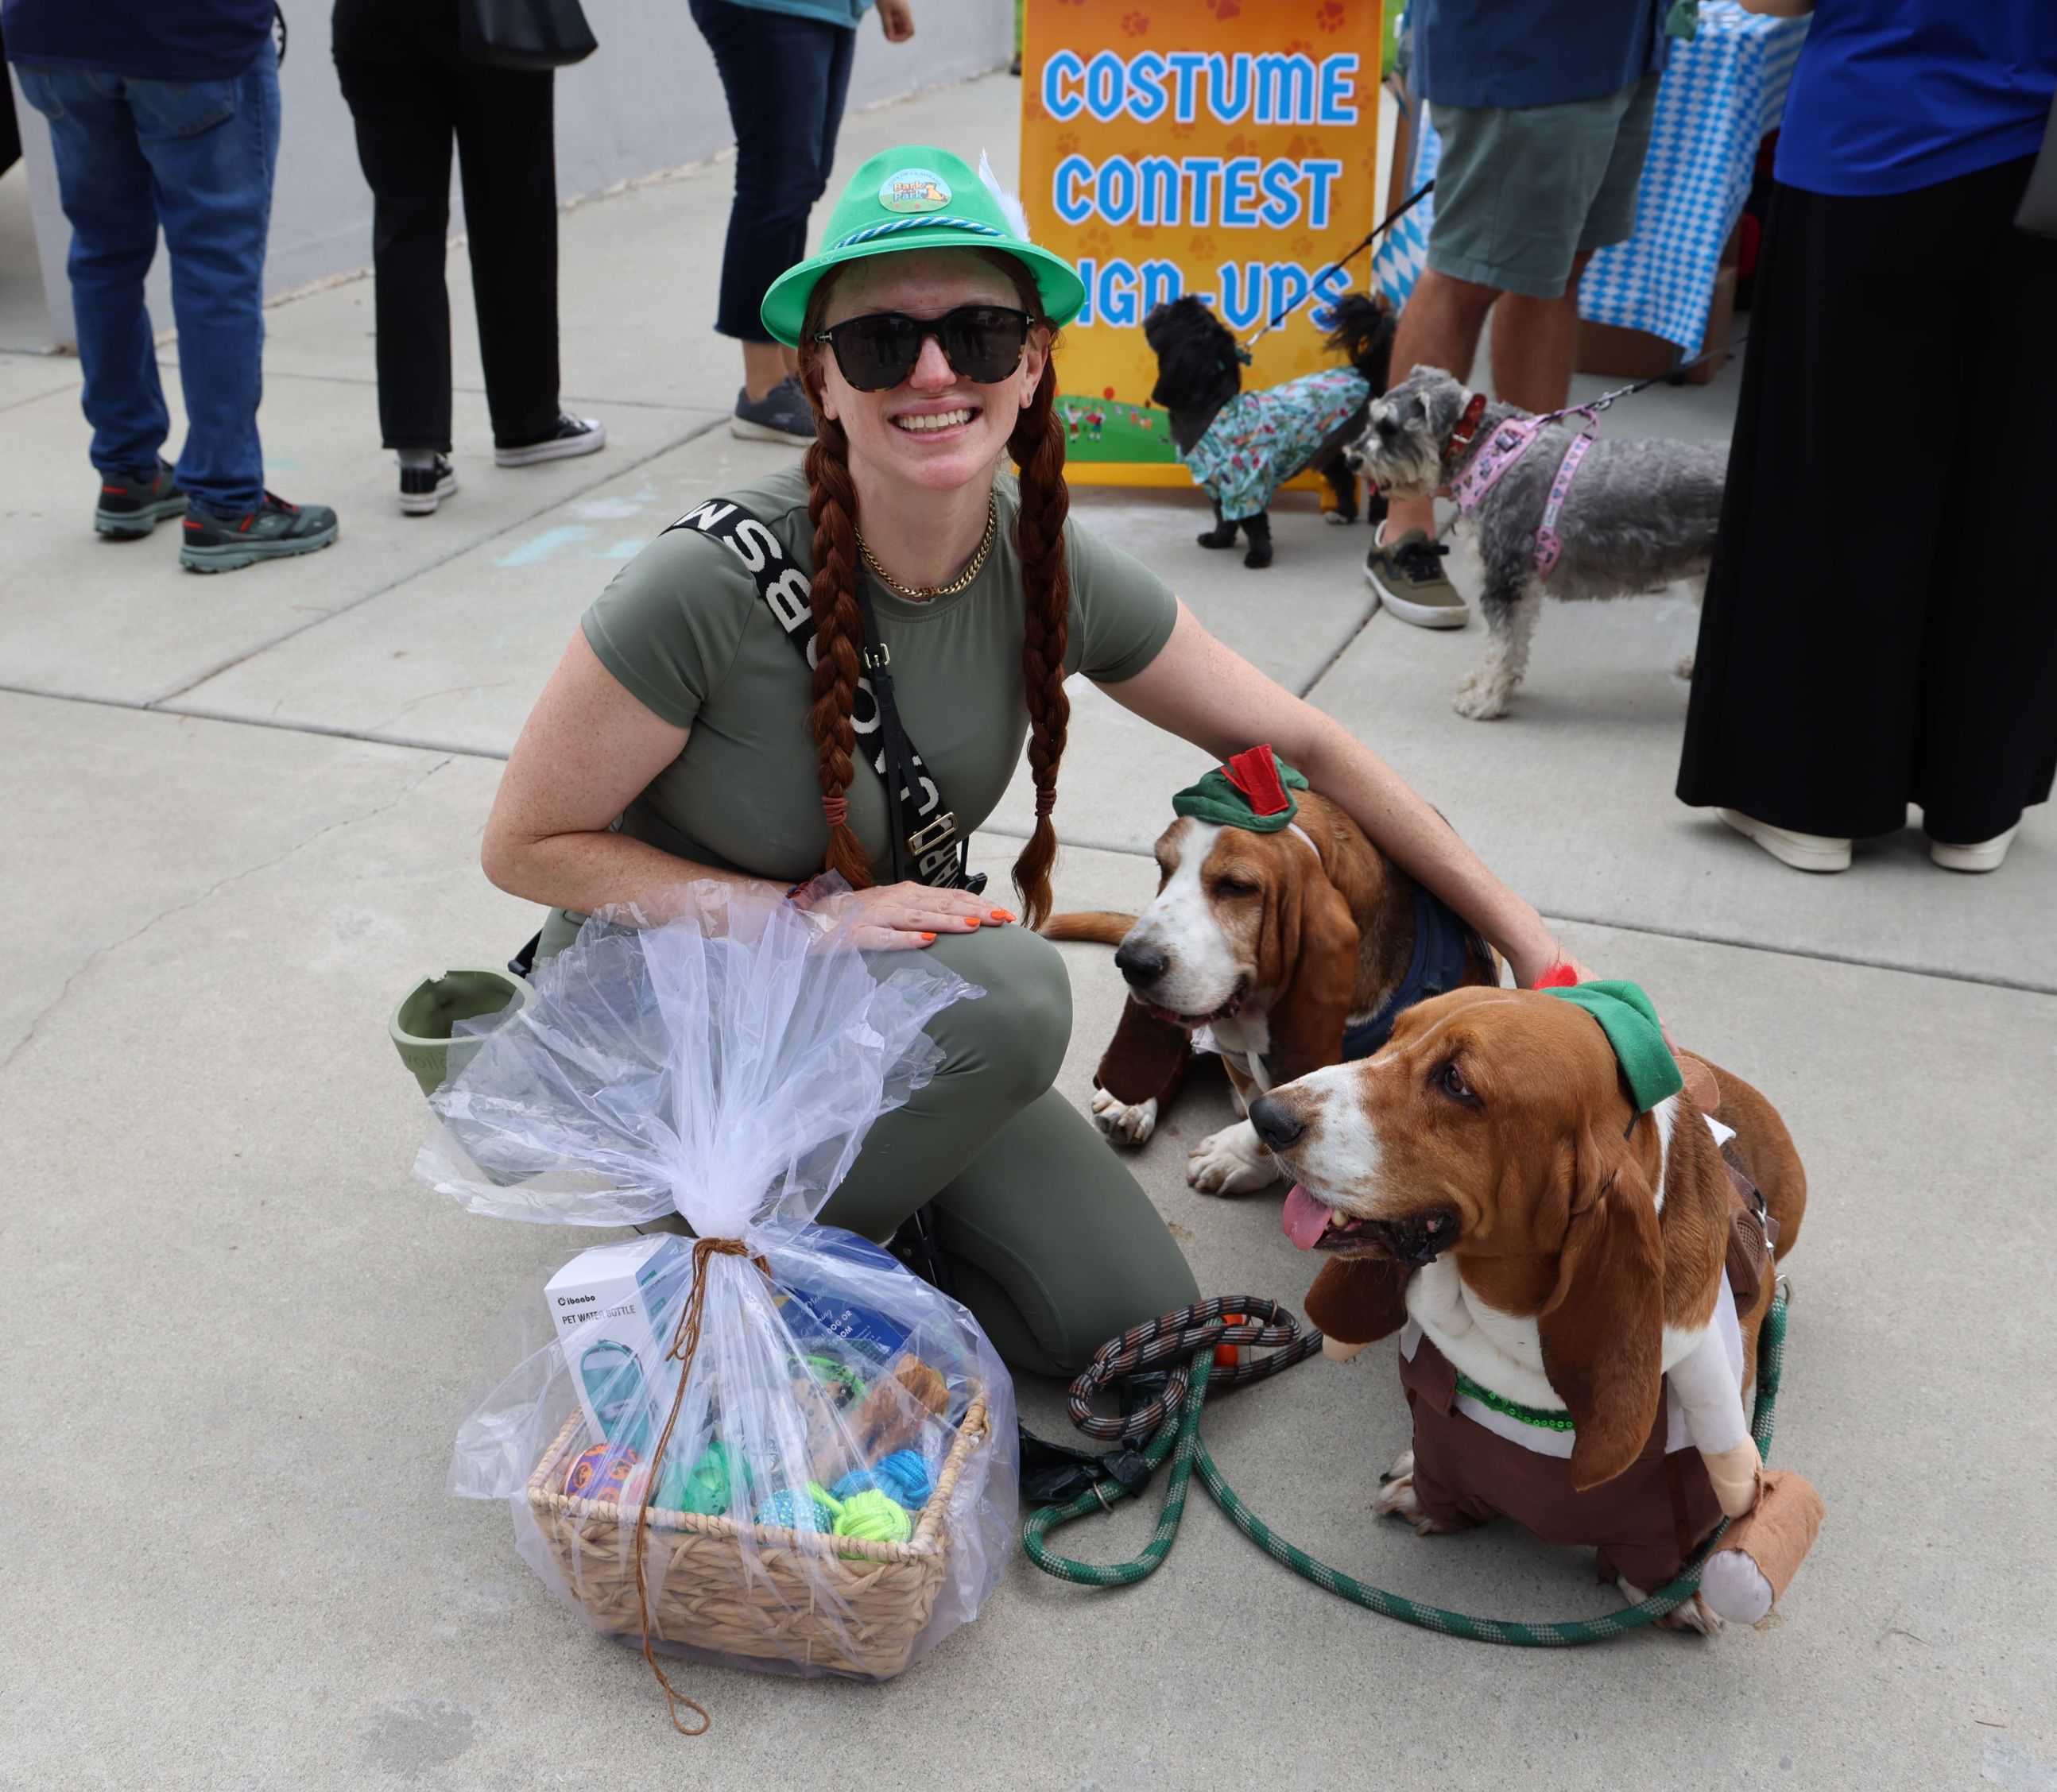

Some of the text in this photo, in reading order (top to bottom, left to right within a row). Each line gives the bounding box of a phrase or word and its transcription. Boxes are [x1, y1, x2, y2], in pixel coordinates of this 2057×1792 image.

[1043, 50, 1359, 126] COSTUME
[1053, 153, 1342, 229] CONTEST
[1076, 256, 1353, 333] IGN-UPS
[562, 1305, 636, 1325] PET WATER BOTTLE
[567, 1295, 595, 1305] ibaabo
[827, 1310, 853, 1334] DOG OR
